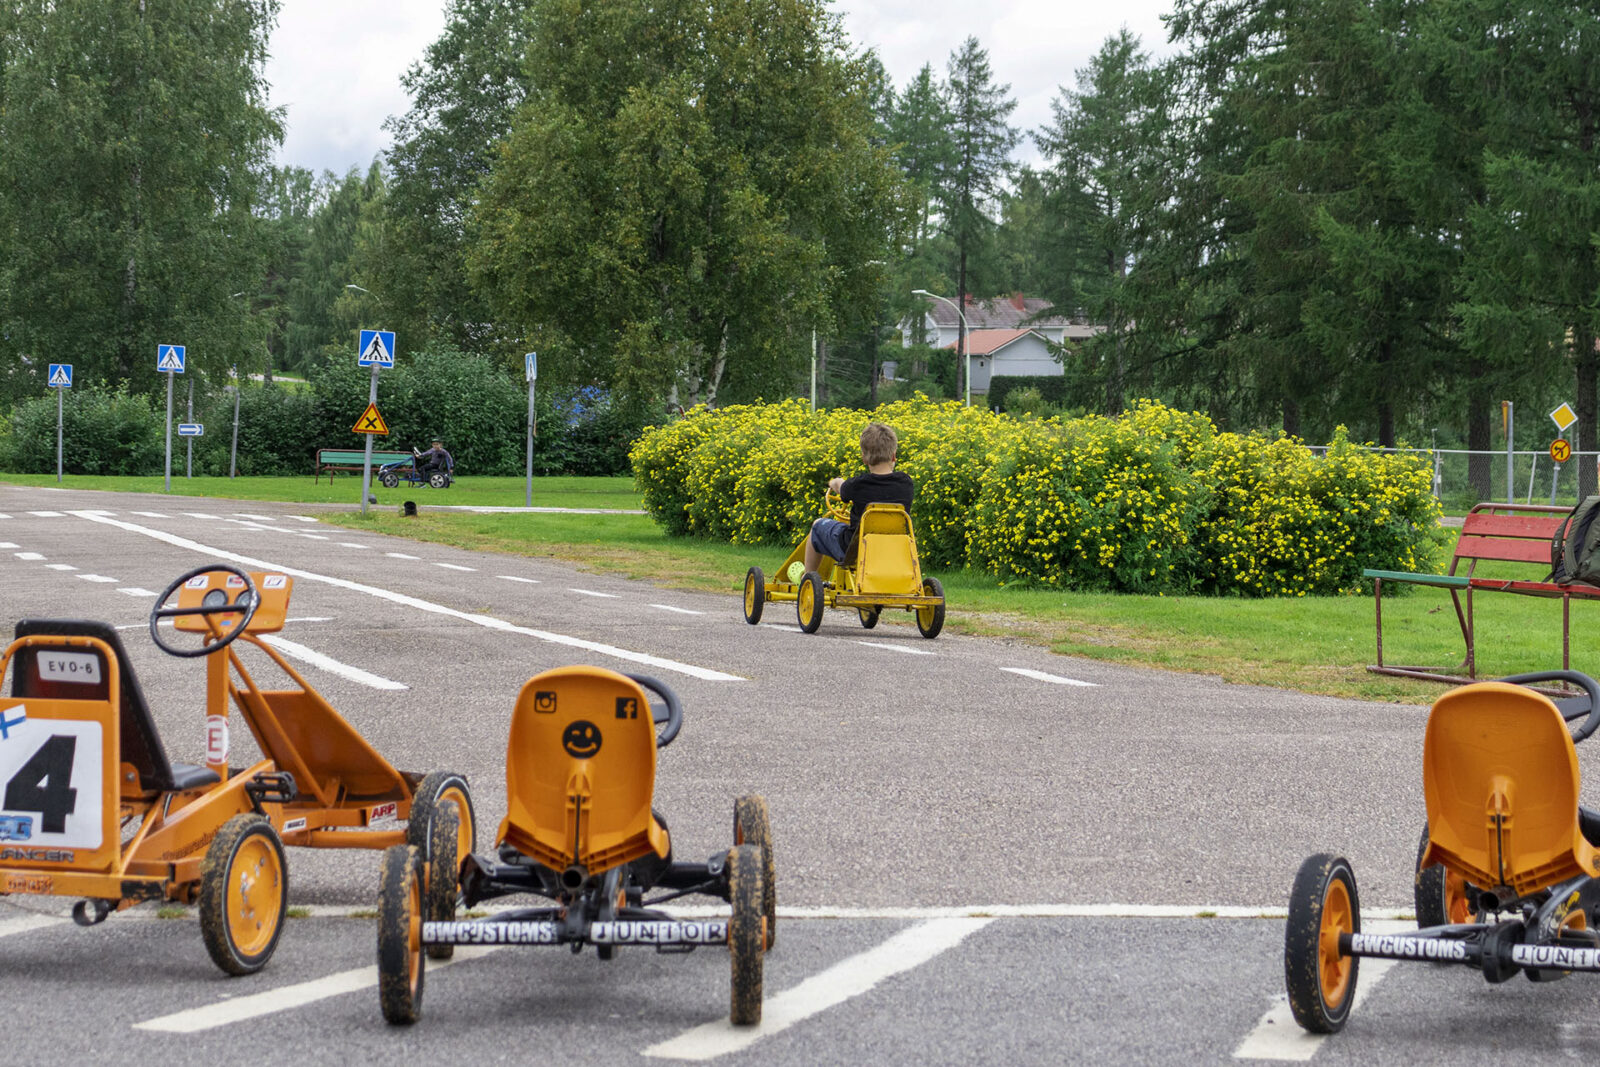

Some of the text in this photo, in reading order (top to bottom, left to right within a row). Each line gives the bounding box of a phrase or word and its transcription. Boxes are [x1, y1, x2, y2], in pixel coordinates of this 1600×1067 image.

[48, 660, 93, 674] EVO-6
[208, 727, 223, 752] E
[2, 734, 78, 834] 4
[371, 803, 396, 818] ARP
[0, 847, 75, 863] ANCER
[595, 922, 722, 941] JUNIOR
[1516, 945, 1600, 966] JUNI
